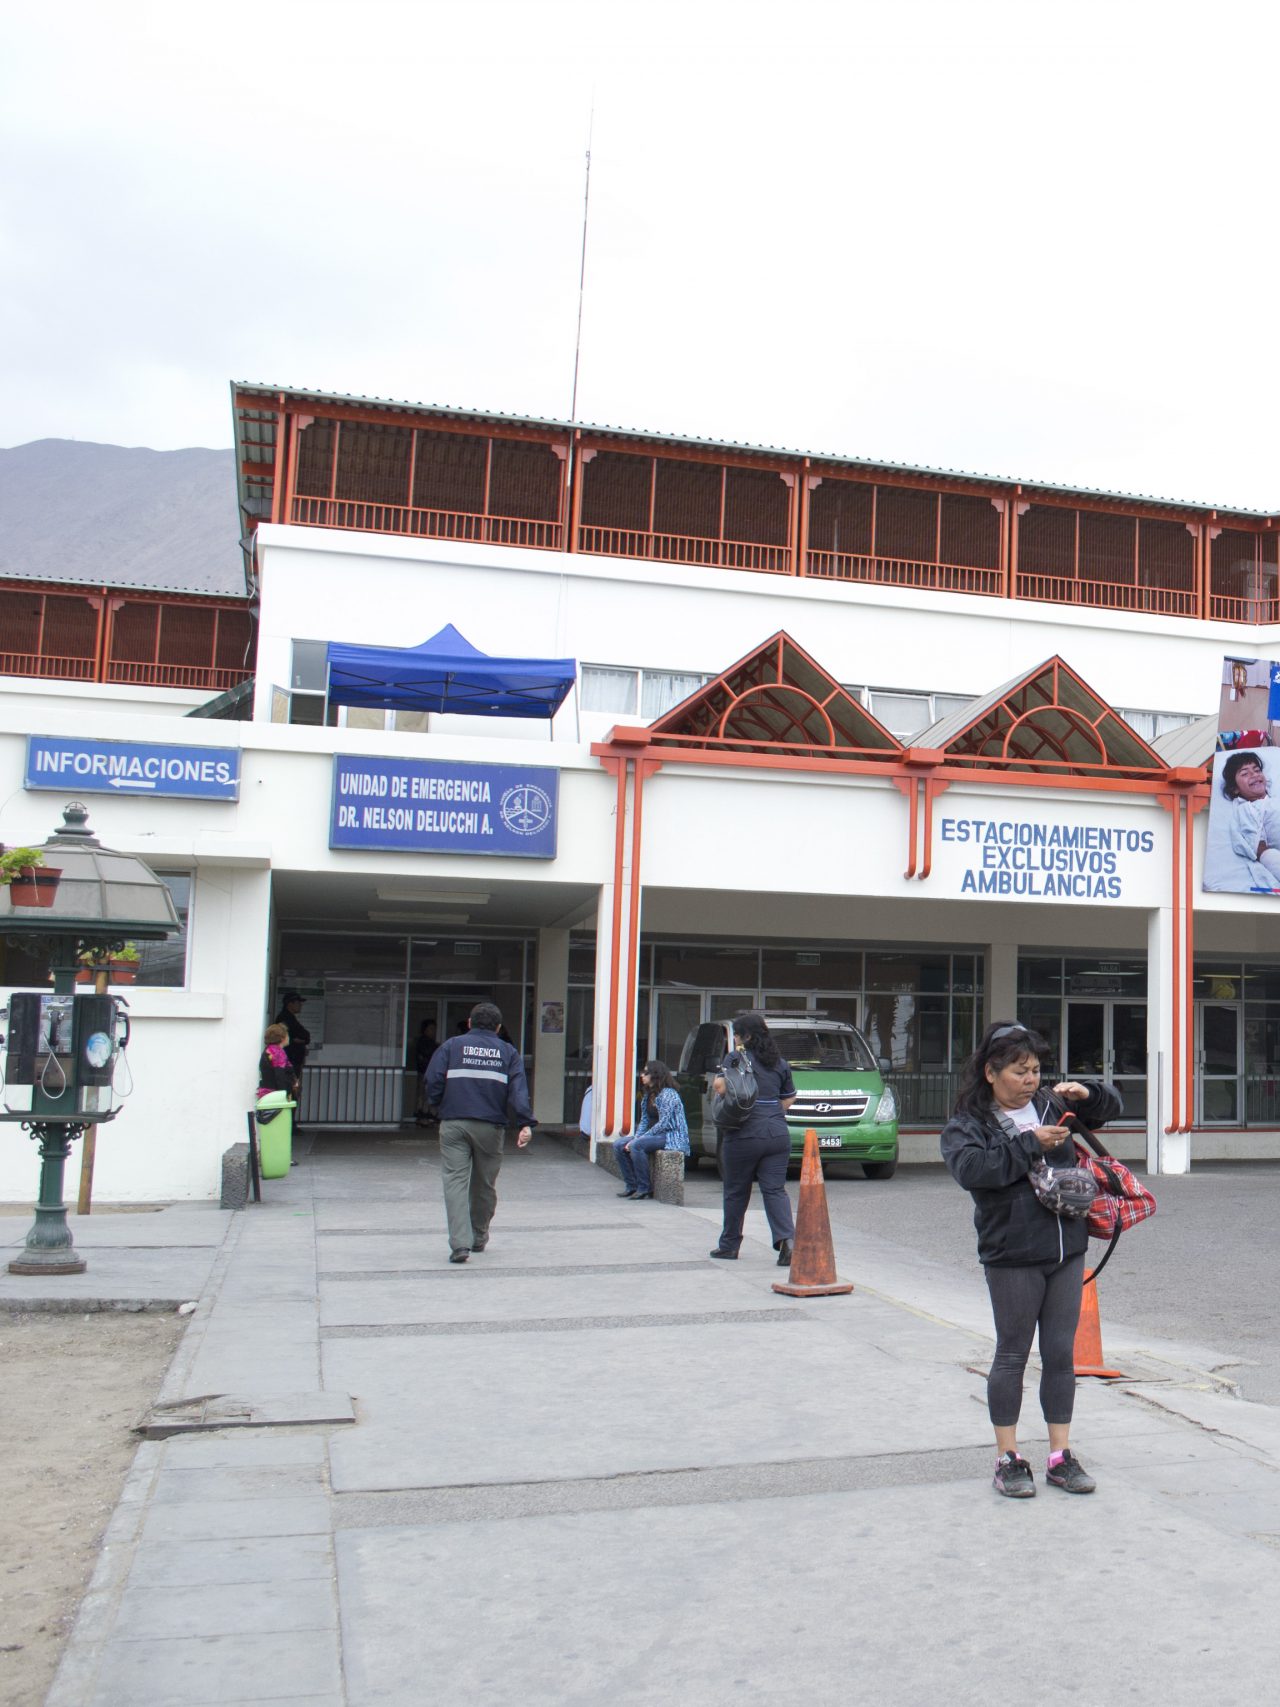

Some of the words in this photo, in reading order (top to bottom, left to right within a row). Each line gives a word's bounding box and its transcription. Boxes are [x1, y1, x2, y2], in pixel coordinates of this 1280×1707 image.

[36, 750, 230, 783] INFORMACIONES
[340, 773, 388, 797] UNIDAD
[391, 776, 408, 799] DE
[411, 777, 491, 803] EMERGENCIA
[338, 806, 360, 828] DR.
[363, 807, 414, 831] NELSON
[417, 811, 478, 835] DELUCCHI
[481, 814, 494, 835] A.
[941, 818, 1155, 852] ESTACIONAMIENTOS
[982, 845, 1117, 874] EXCLUSIVOS
[961, 869, 1122, 899] AMBULANCIAS
[463, 1046, 501, 1058] URGENCIA
